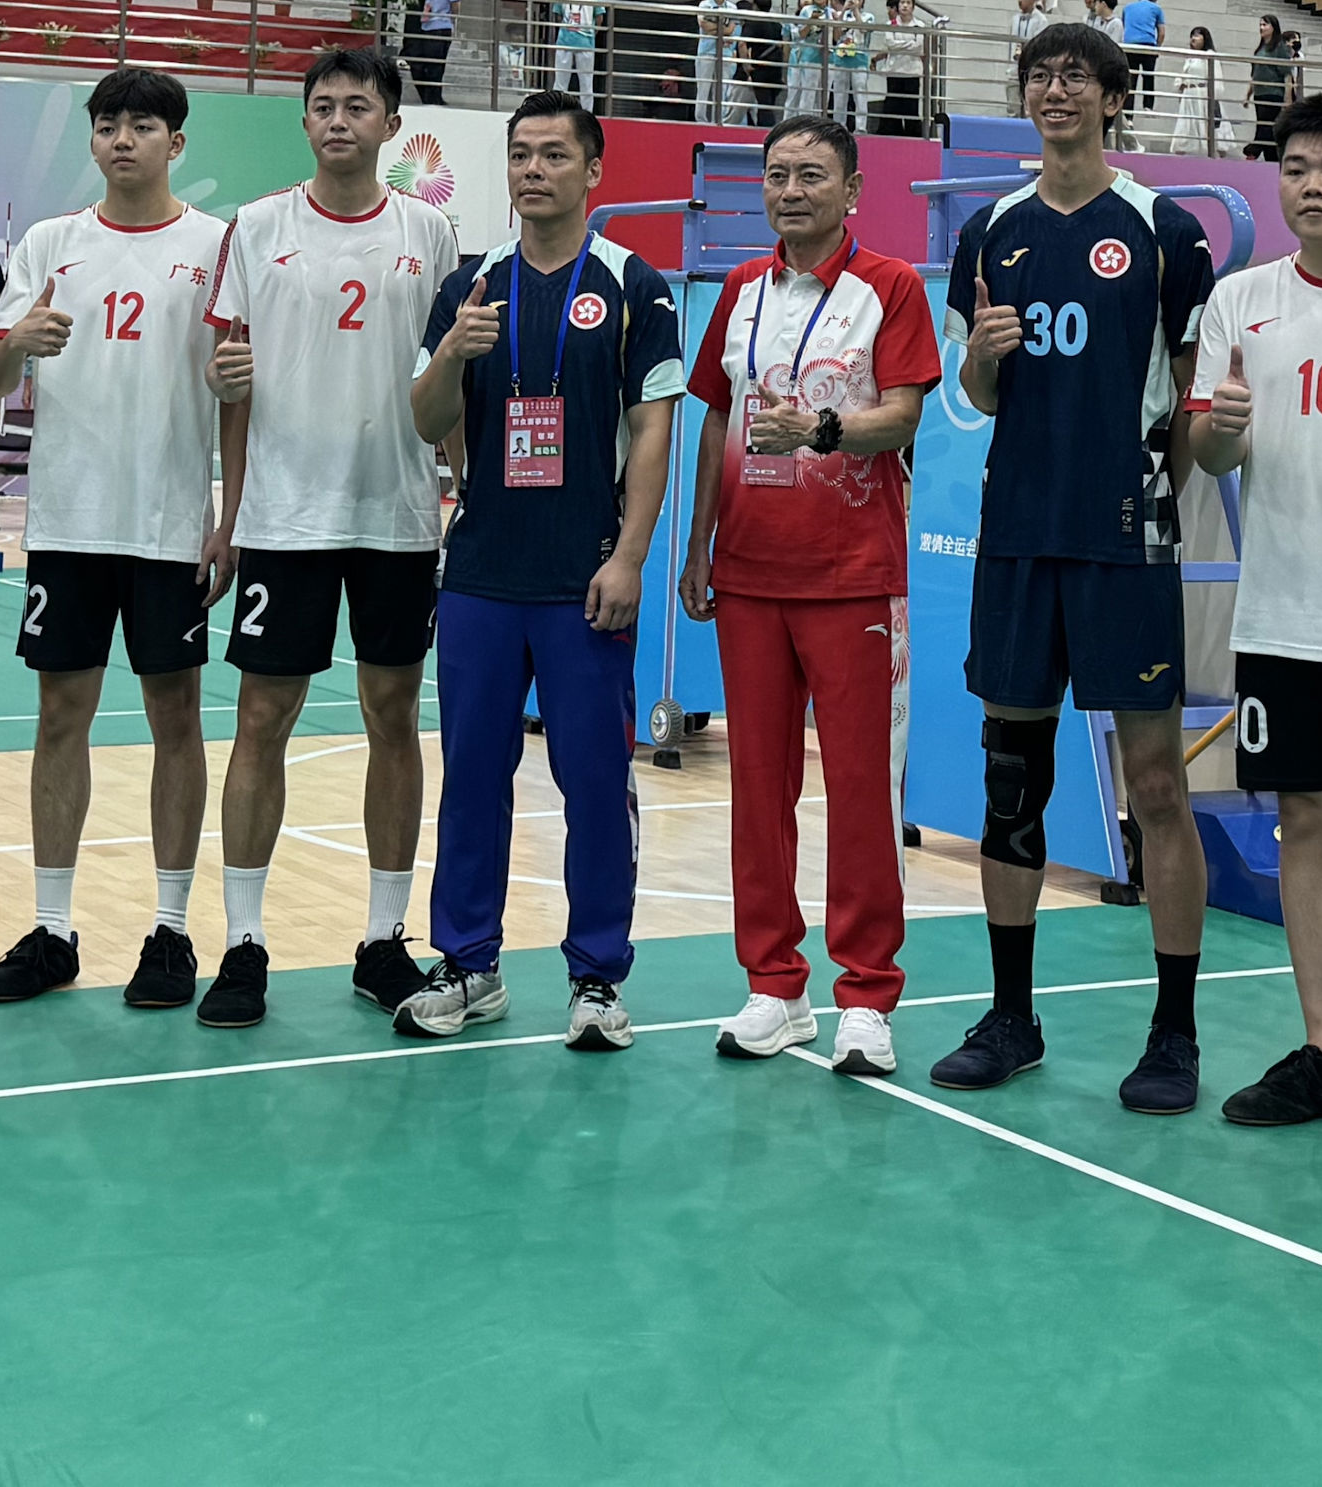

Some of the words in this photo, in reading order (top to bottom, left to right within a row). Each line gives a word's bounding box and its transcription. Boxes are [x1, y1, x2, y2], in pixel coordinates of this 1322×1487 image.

[169, 263, 209, 286] 广东
[394, 255, 423, 276] 广东
[103, 291, 144, 340] 12
[338, 280, 366, 330] 2
[823, 314, 852, 329] 广东
[1024, 301, 1088, 357] 30
[919, 532, 978, 558] 激情全运会
[24, 580, 48, 636] 2
[240, 583, 269, 637] 2
